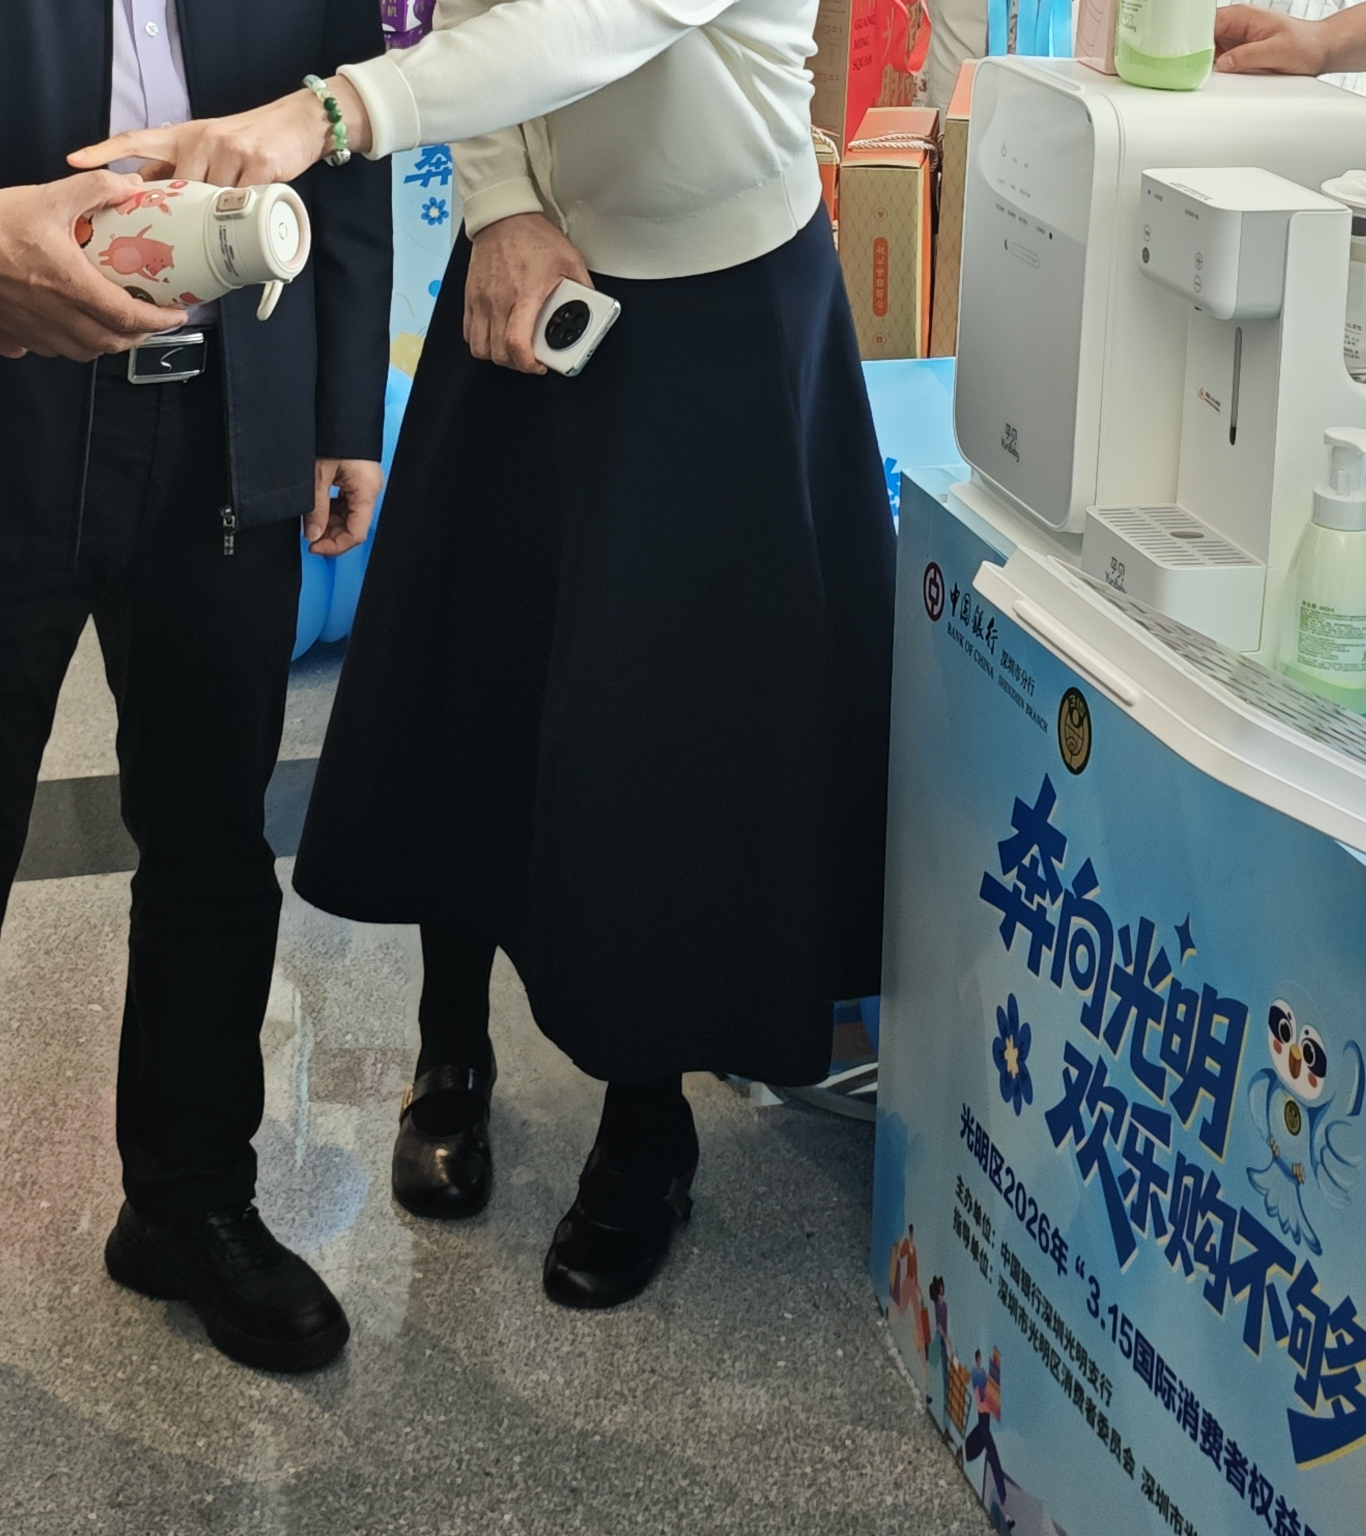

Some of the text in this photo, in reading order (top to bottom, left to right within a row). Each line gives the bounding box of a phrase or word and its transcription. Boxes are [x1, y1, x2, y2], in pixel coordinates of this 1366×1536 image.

[947, 622, 965, 649] BANK
[973, 649, 995, 680] CHINA
[1025, 702, 1048, 734] BRANCH
[950, 582, 1036, 698] 中国银行 深圳市分行
[979, 772, 1250, 1159] 奔向光明
